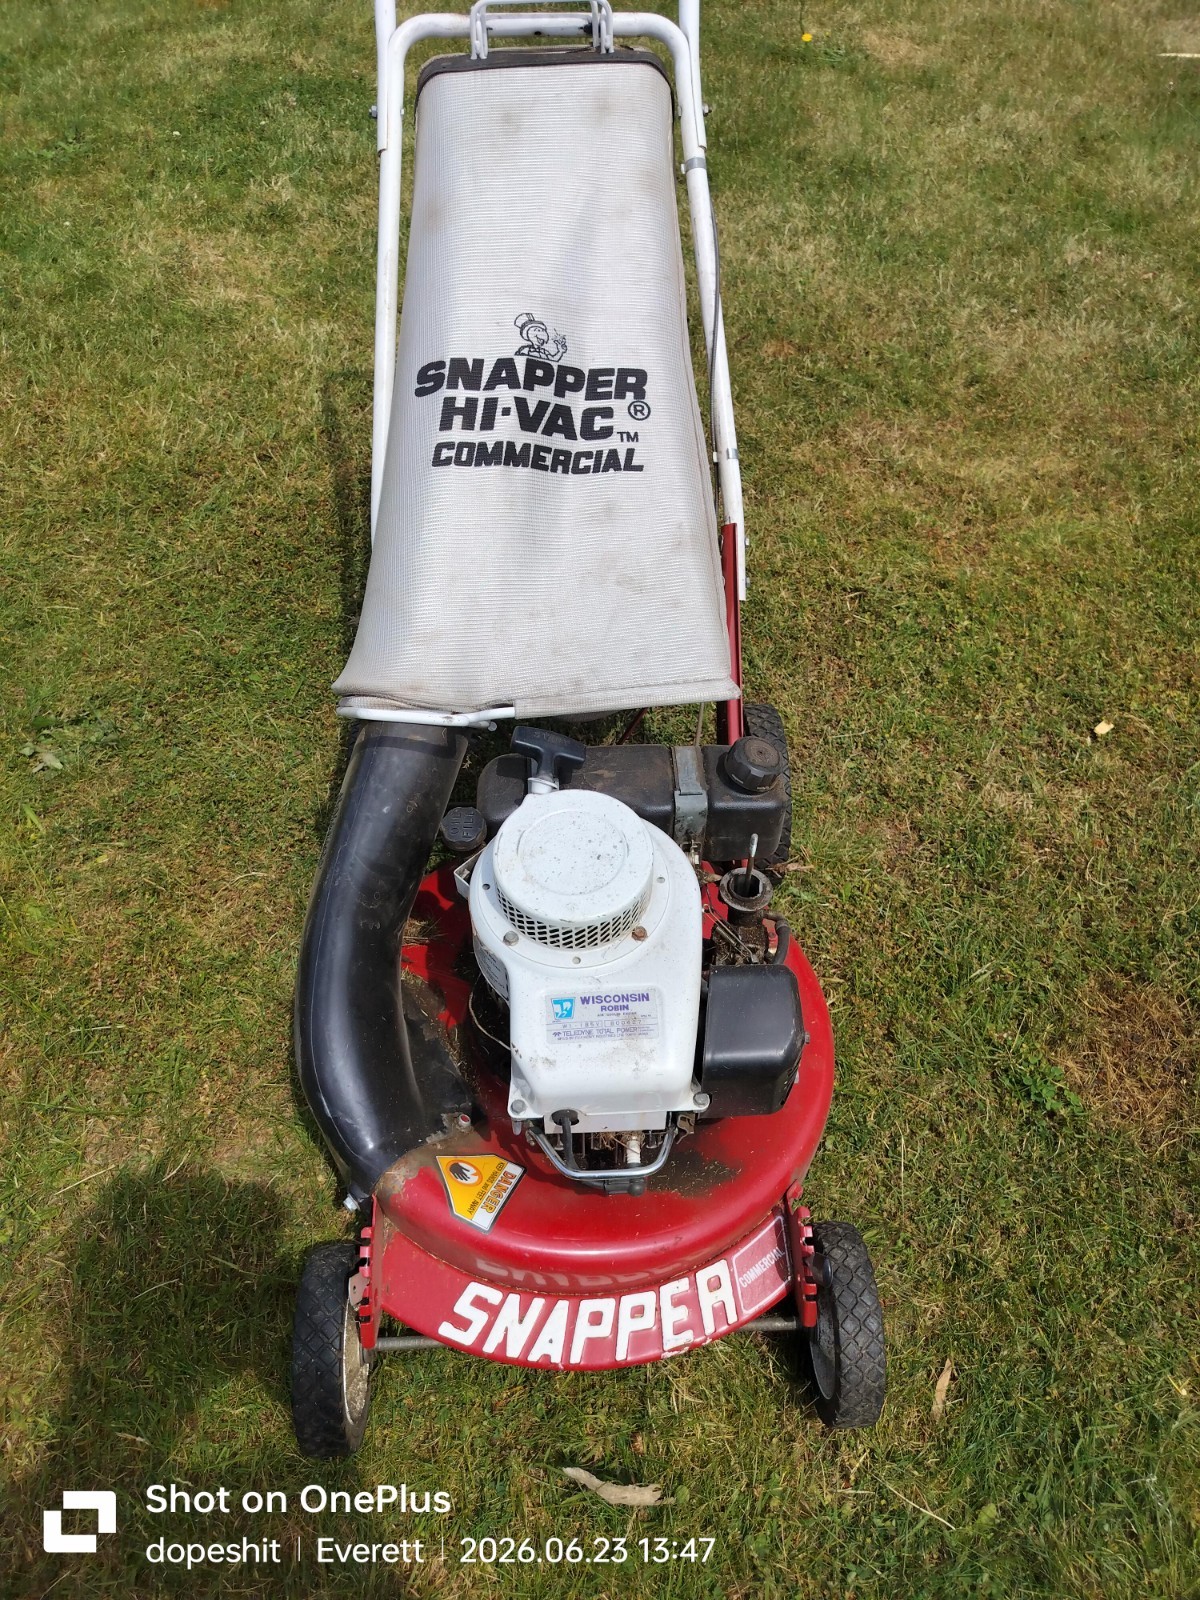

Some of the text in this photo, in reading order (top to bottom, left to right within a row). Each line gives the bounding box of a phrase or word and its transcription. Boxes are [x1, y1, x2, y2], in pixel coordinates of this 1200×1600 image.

[414, 357, 648, 401] SNAPPER
[431, 441, 645, 475] COMMERCIAL
[462, 811, 474, 839] FILL
[580, 992, 650, 1005] WISCONSIN
[600, 1004, 630, 1012] ROBIN
[563, 1029, 594, 1037] TELEDYNE
[596, 1028, 614, 1036] TOTAL
[616, 1026, 638, 1034] POWER
[480, 1170, 517, 1213] DANGER
[739, 1246, 785, 1288] COMMERCIAL
[437, 1258, 738, 1365] SNAPPER
